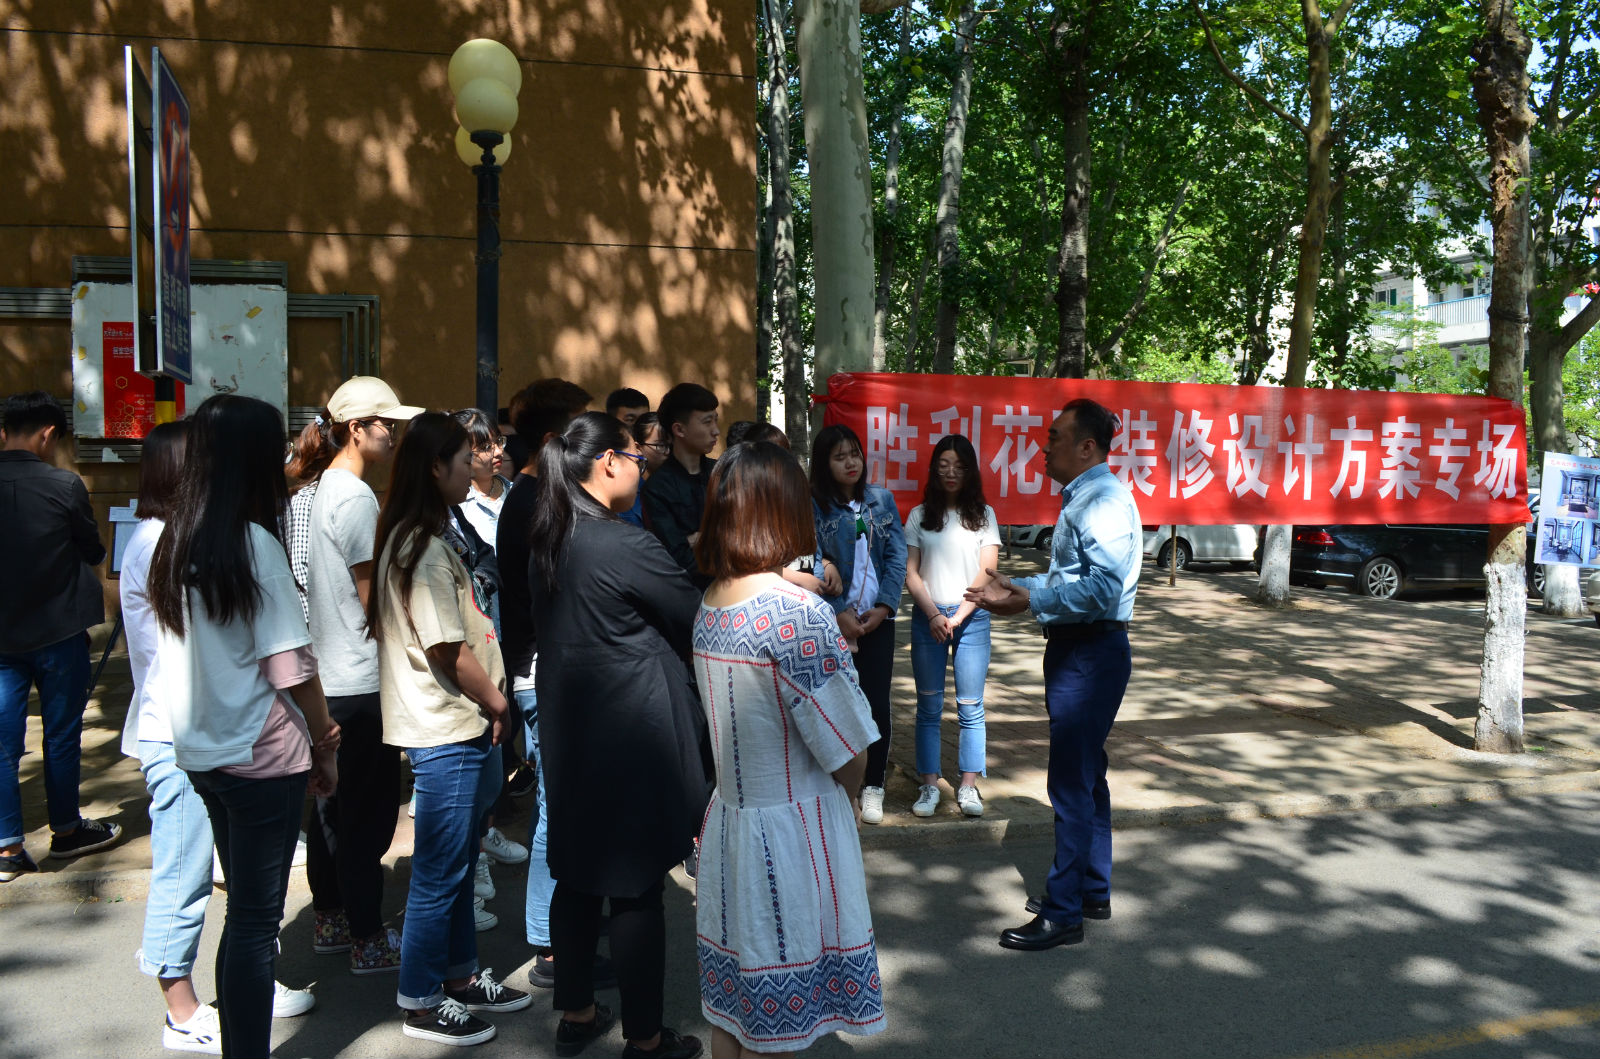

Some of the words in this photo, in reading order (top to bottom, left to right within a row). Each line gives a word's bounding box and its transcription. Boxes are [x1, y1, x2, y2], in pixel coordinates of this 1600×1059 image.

[866, 403, 1518, 501] 胜利花装修设计方案专场
